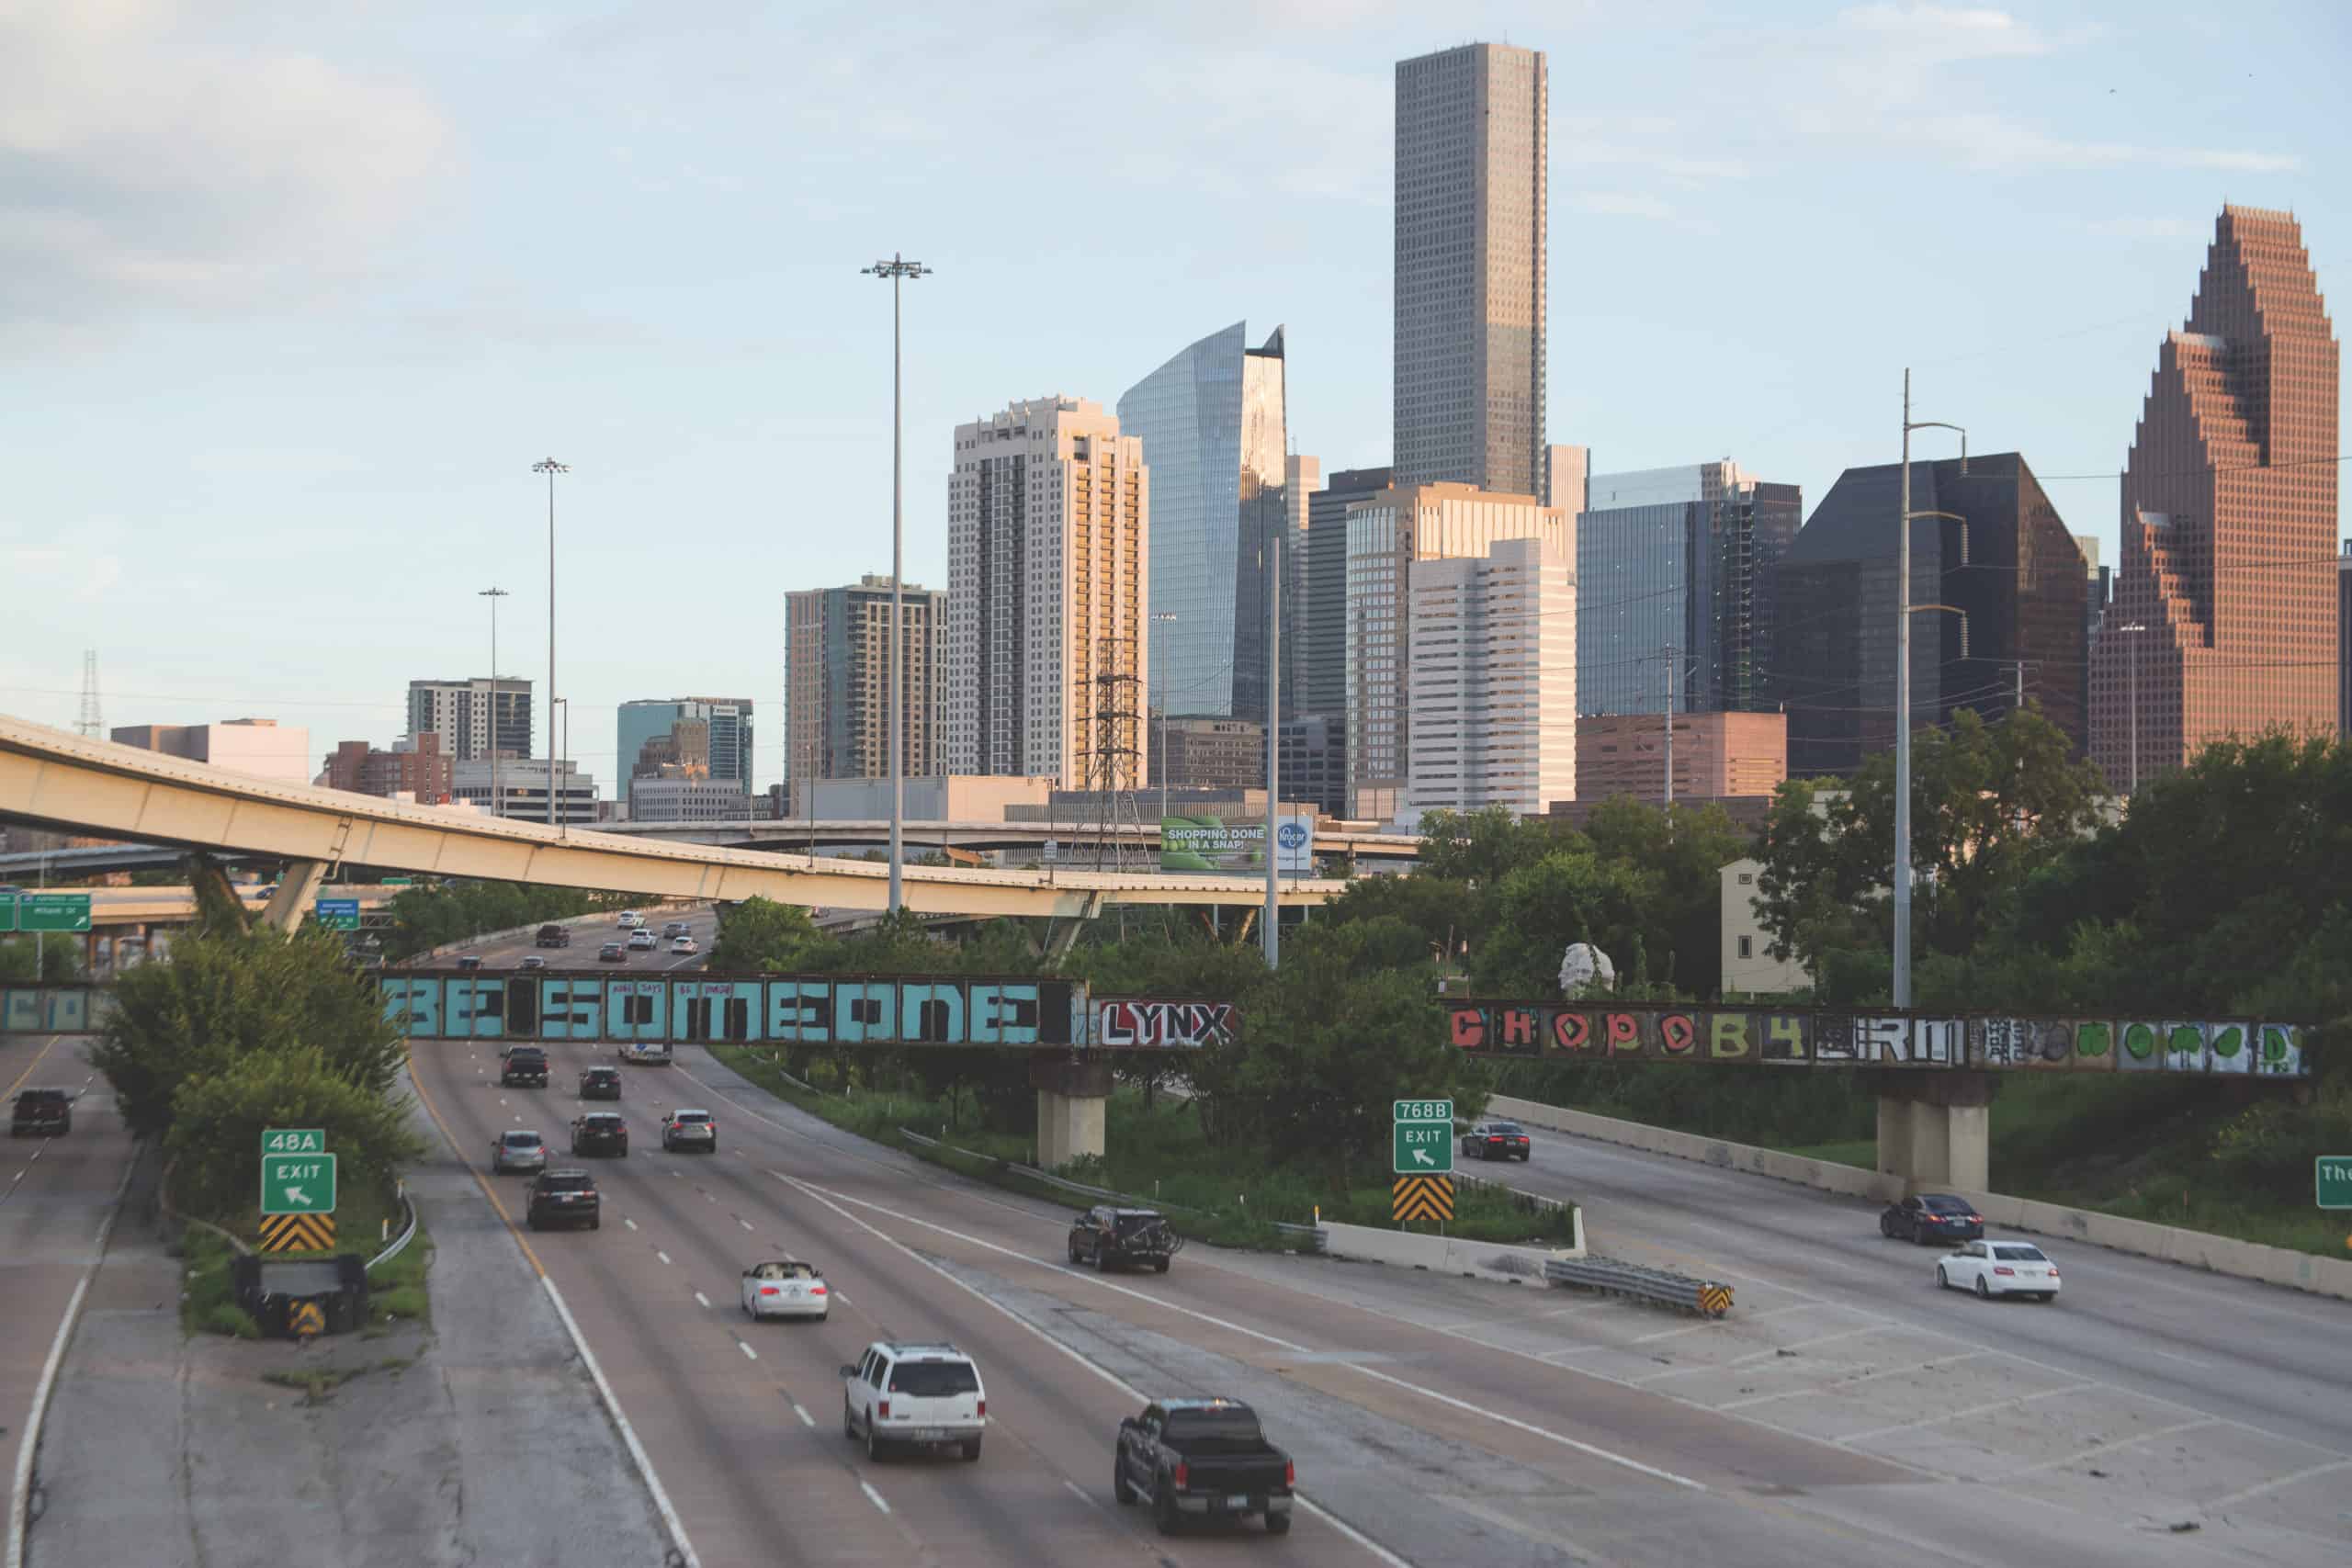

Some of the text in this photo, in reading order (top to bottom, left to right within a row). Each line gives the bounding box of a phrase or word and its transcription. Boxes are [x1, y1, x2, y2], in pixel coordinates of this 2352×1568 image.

[1169, 829, 1265, 840] SHOPPING DONE
[1189, 840, 1244, 850] IN A SNAP!
[543, 979, 1038, 1043] SOMEONE
[1103, 999, 1238, 1046] LYNX
[1401, 1102, 1447, 1118] 768B
[269, 1133, 317, 1151] 48A
[1406, 1130, 1442, 1144] EXIT
[277, 1164, 322, 1179] EXIT
